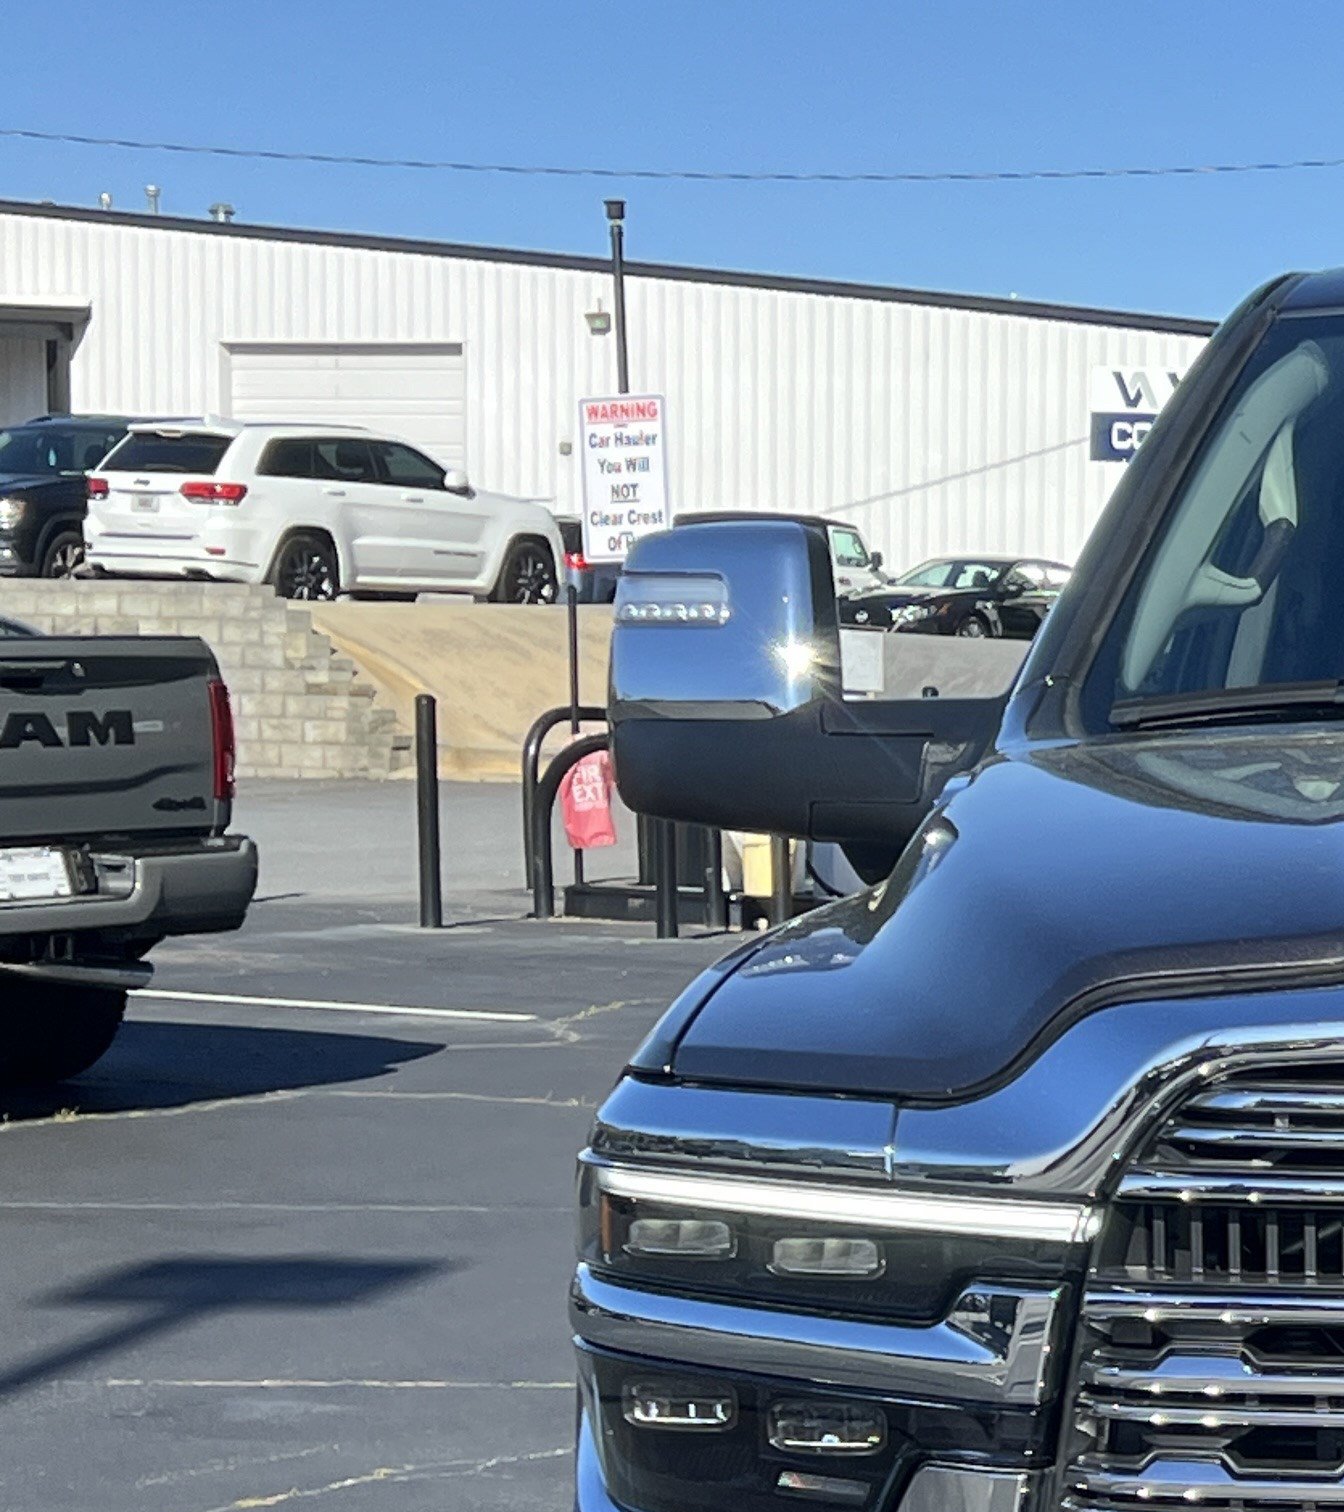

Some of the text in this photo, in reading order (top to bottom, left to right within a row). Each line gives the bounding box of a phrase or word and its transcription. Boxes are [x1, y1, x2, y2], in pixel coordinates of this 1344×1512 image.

[586, 401, 658, 421] WARNING
[589, 432, 610, 449] Car
[598, 457, 621, 474] You
[611, 483, 640, 500] NOT
[591, 509, 664, 527] Clear Crest
[608, 535, 622, 552] Of
